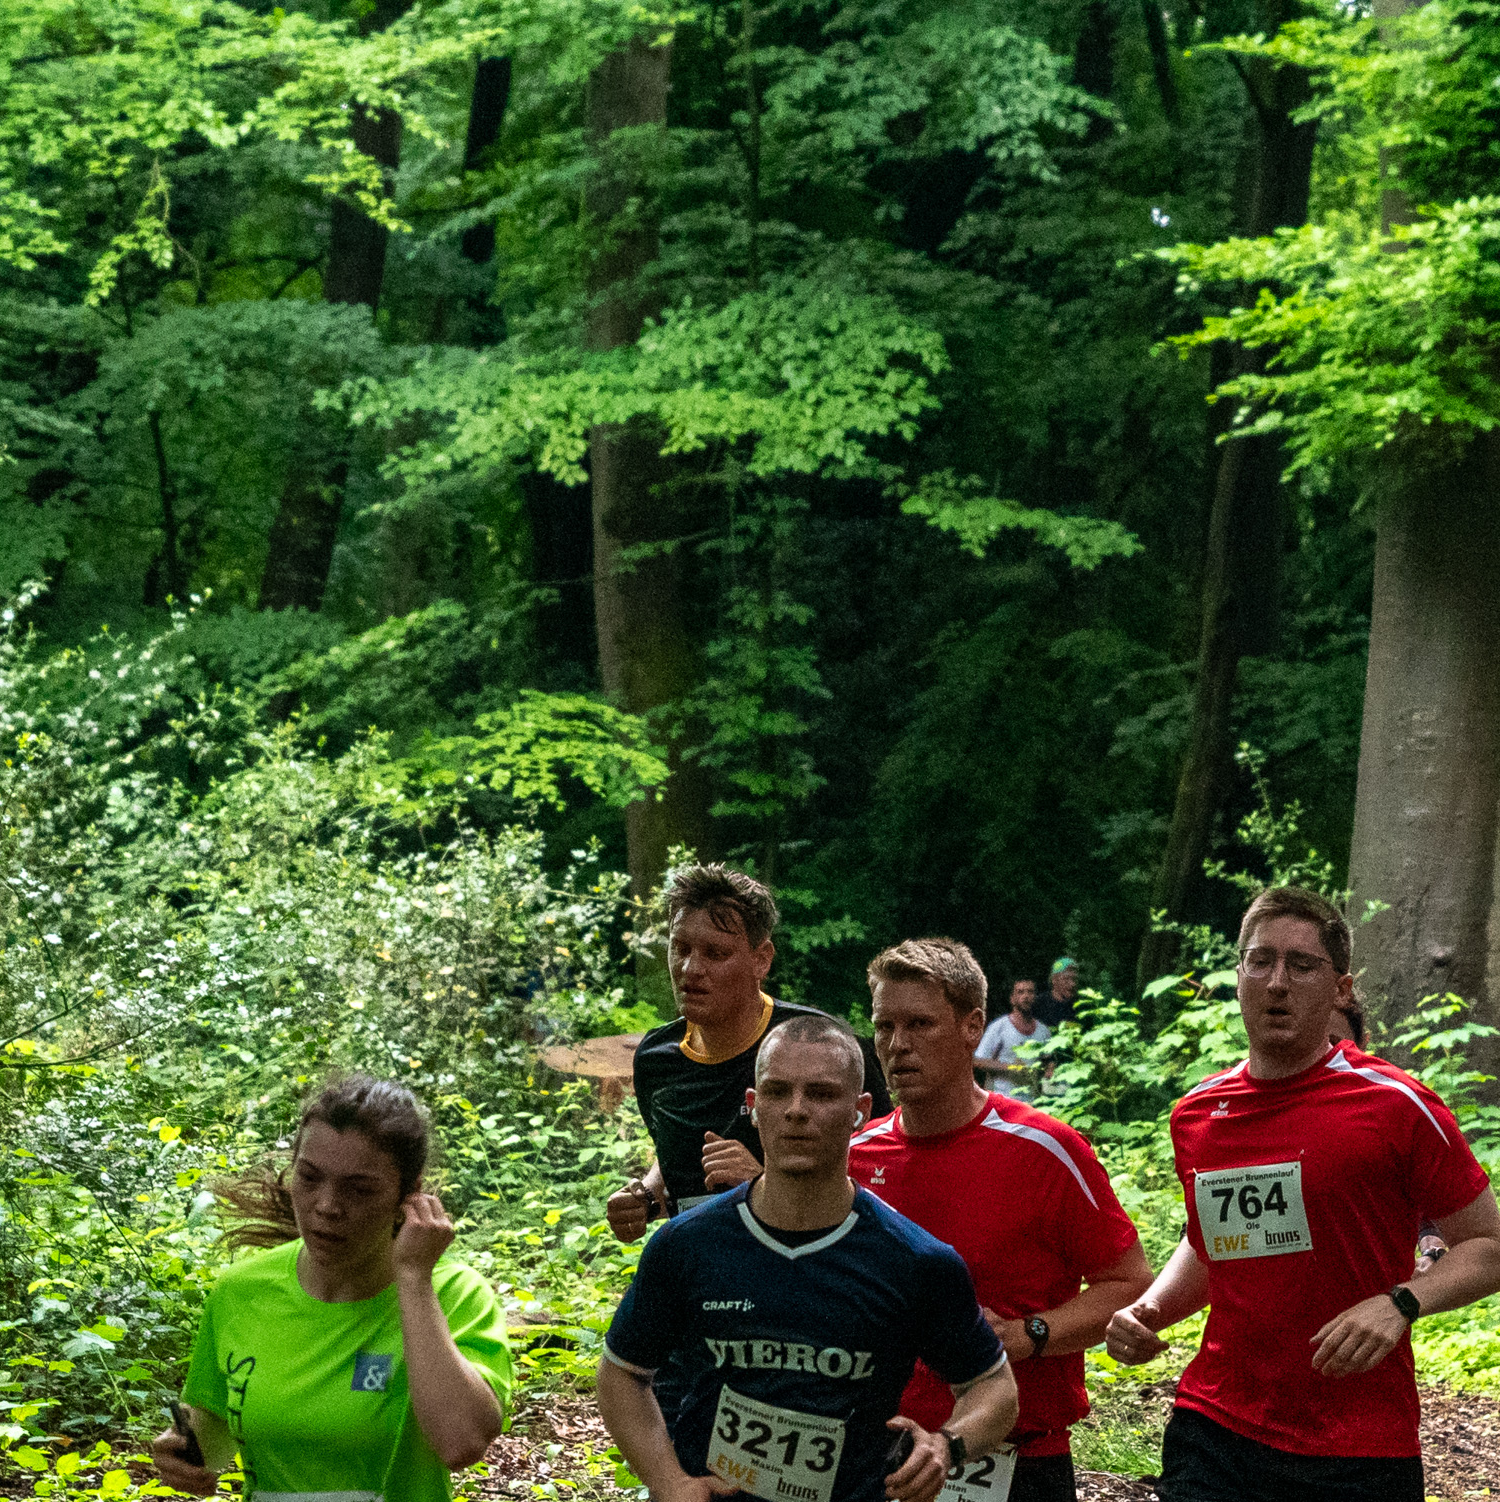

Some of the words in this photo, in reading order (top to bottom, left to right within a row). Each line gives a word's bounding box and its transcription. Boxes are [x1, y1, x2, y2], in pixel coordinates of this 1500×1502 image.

[1201, 1176, 1244, 1187] Everstener
[1245, 1169, 1294, 1182] Brunnenlauf
[1211, 1181, 1288, 1223] 764
[1246, 1222, 1261, 1230] Ole
[1214, 1233, 1250, 1254] EWE
[1264, 1230, 1301, 1246] bruns
[702, 1301, 742, 1311] CRAFT
[704, 1337, 876, 1380] VIEROL
[726, 1396, 775, 1421] Everstener
[777, 1415, 838, 1434] Brunnenlauf
[716, 1406, 837, 1473] 3213
[716, 1453, 759, 1488] EWE
[751, 1457, 784, 1475] Maxim
[776, 1476, 820, 1501] bruns
